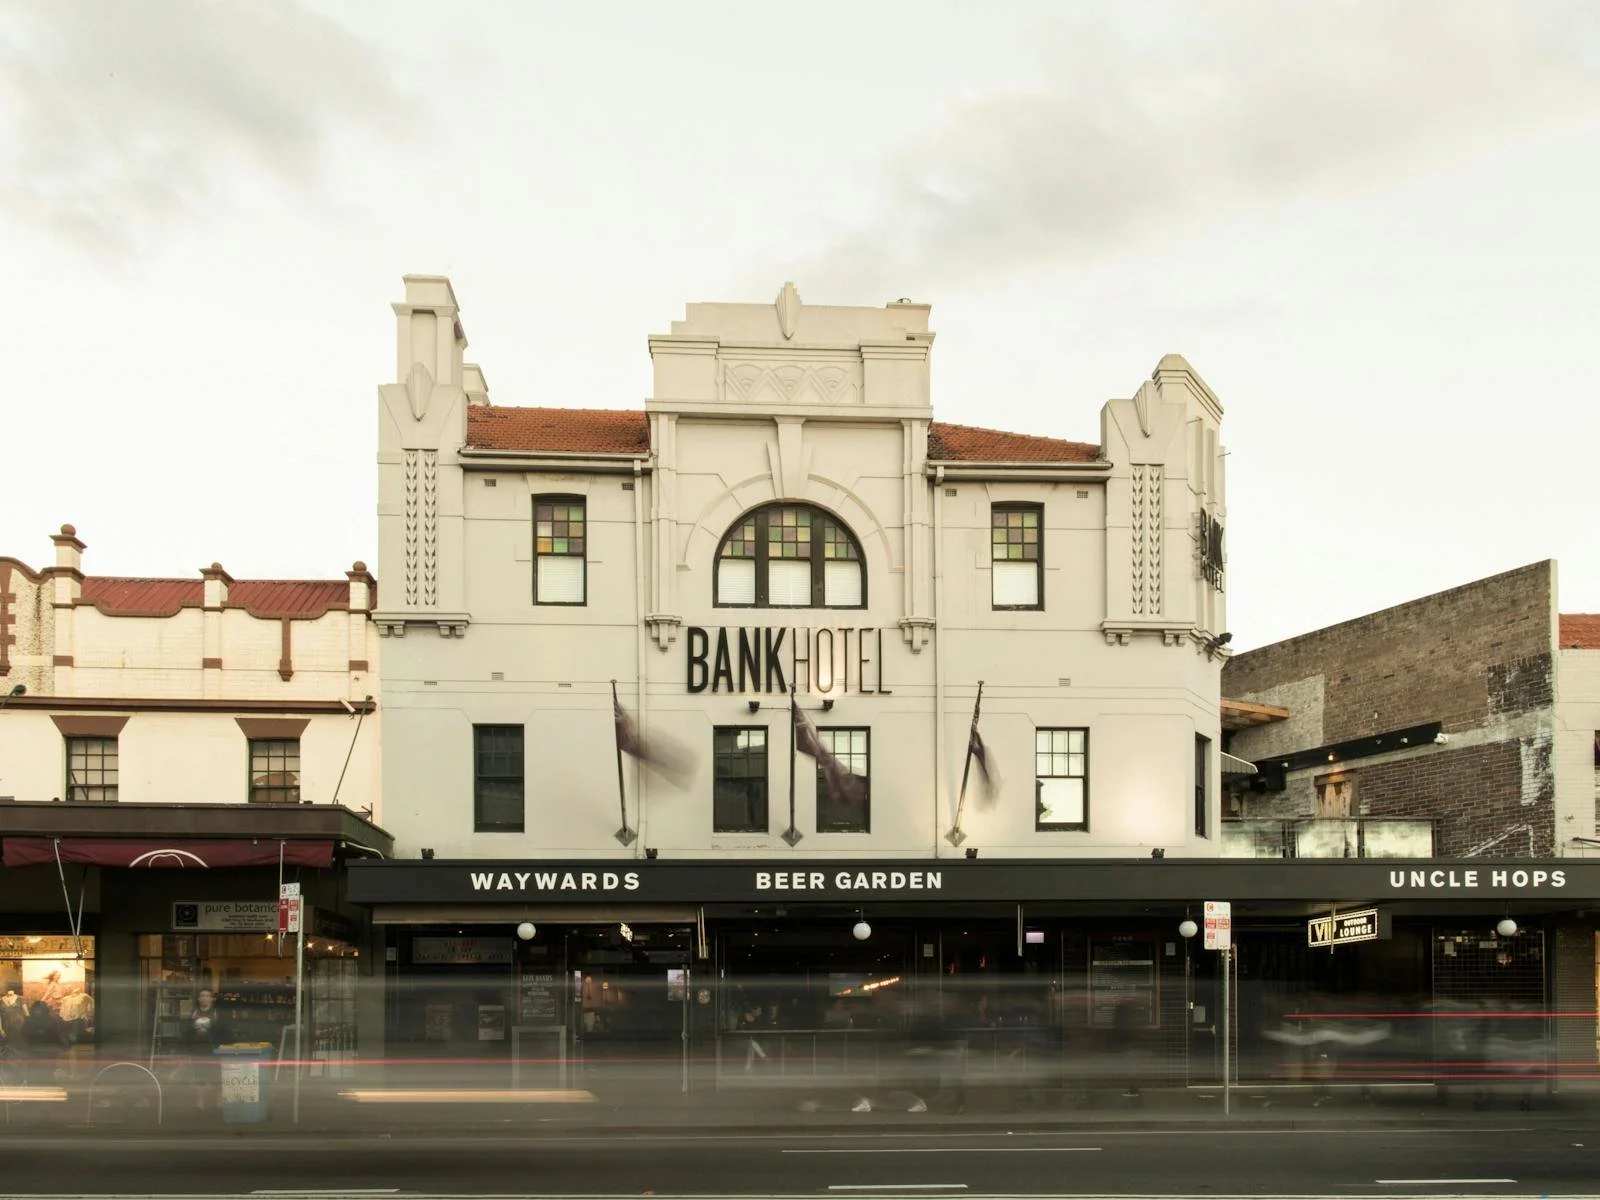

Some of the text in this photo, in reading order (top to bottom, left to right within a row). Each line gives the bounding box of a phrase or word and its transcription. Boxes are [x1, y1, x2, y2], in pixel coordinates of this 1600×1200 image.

[687, 626, 892, 694] BANK HOTEL
[470, 872, 640, 890] WAYWARDS
[756, 872, 942, 889] BEER GARDEN
[1390, 870, 1566, 888] UNCLE HOPS
[205, 904, 230, 915] pure
[1344, 917, 1367, 926] OUTDOOR
[1314, 921, 1337, 942] VIP
[1340, 924, 1372, 937] LOUNGE
